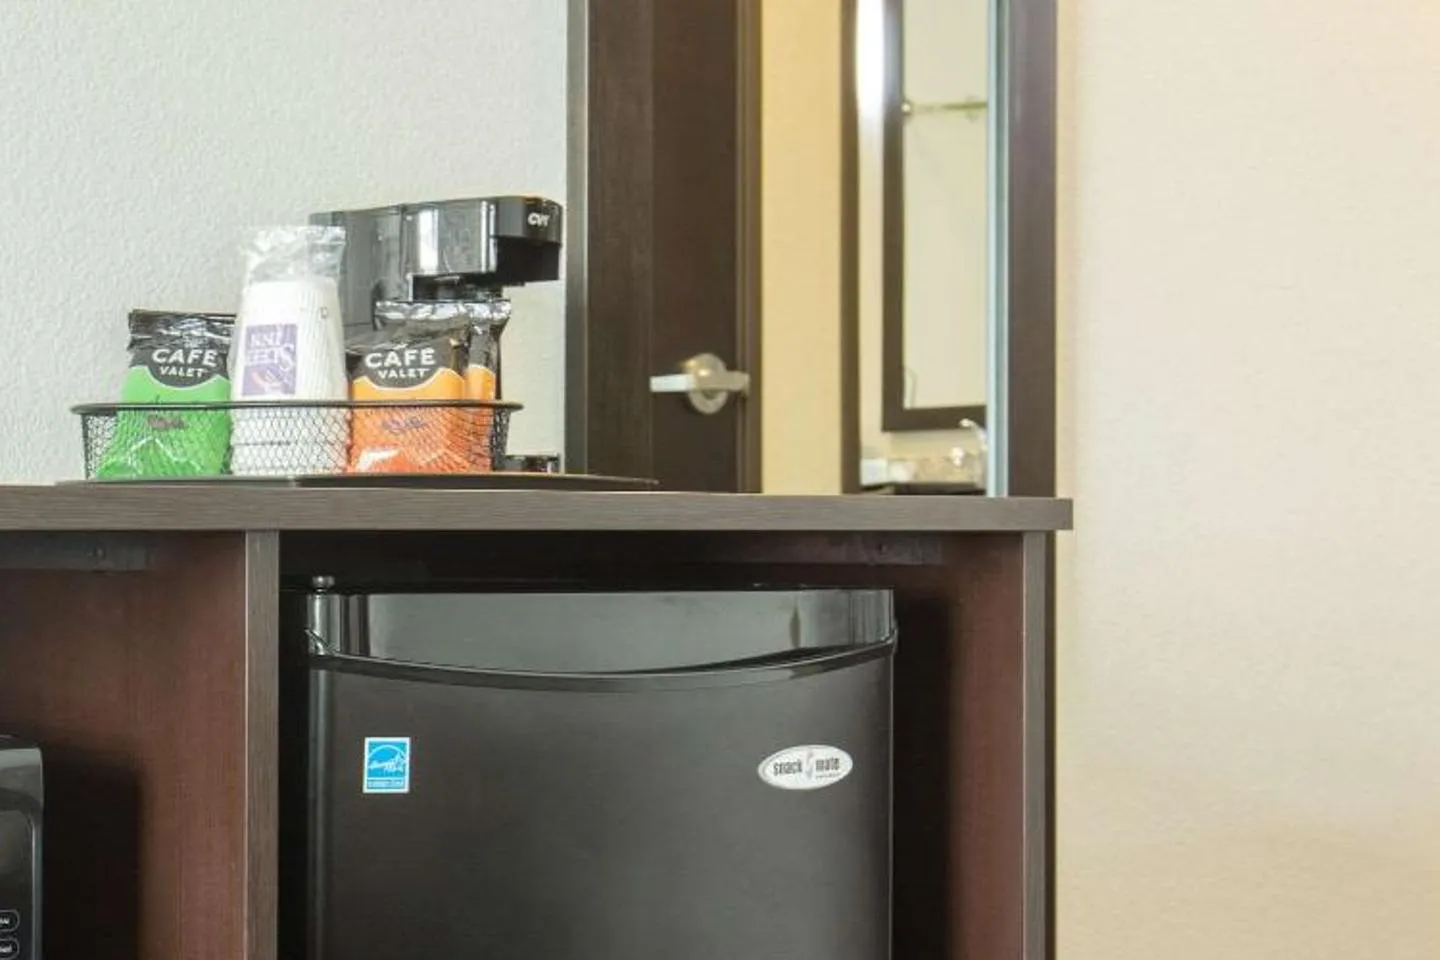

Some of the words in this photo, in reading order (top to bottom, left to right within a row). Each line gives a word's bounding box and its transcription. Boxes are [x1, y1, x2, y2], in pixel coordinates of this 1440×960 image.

[160, 366, 206, 378] VALET
[378, 368, 429, 379] VALET
[773, 759, 802, 776] snack
[815, 758, 840, 772] mate
